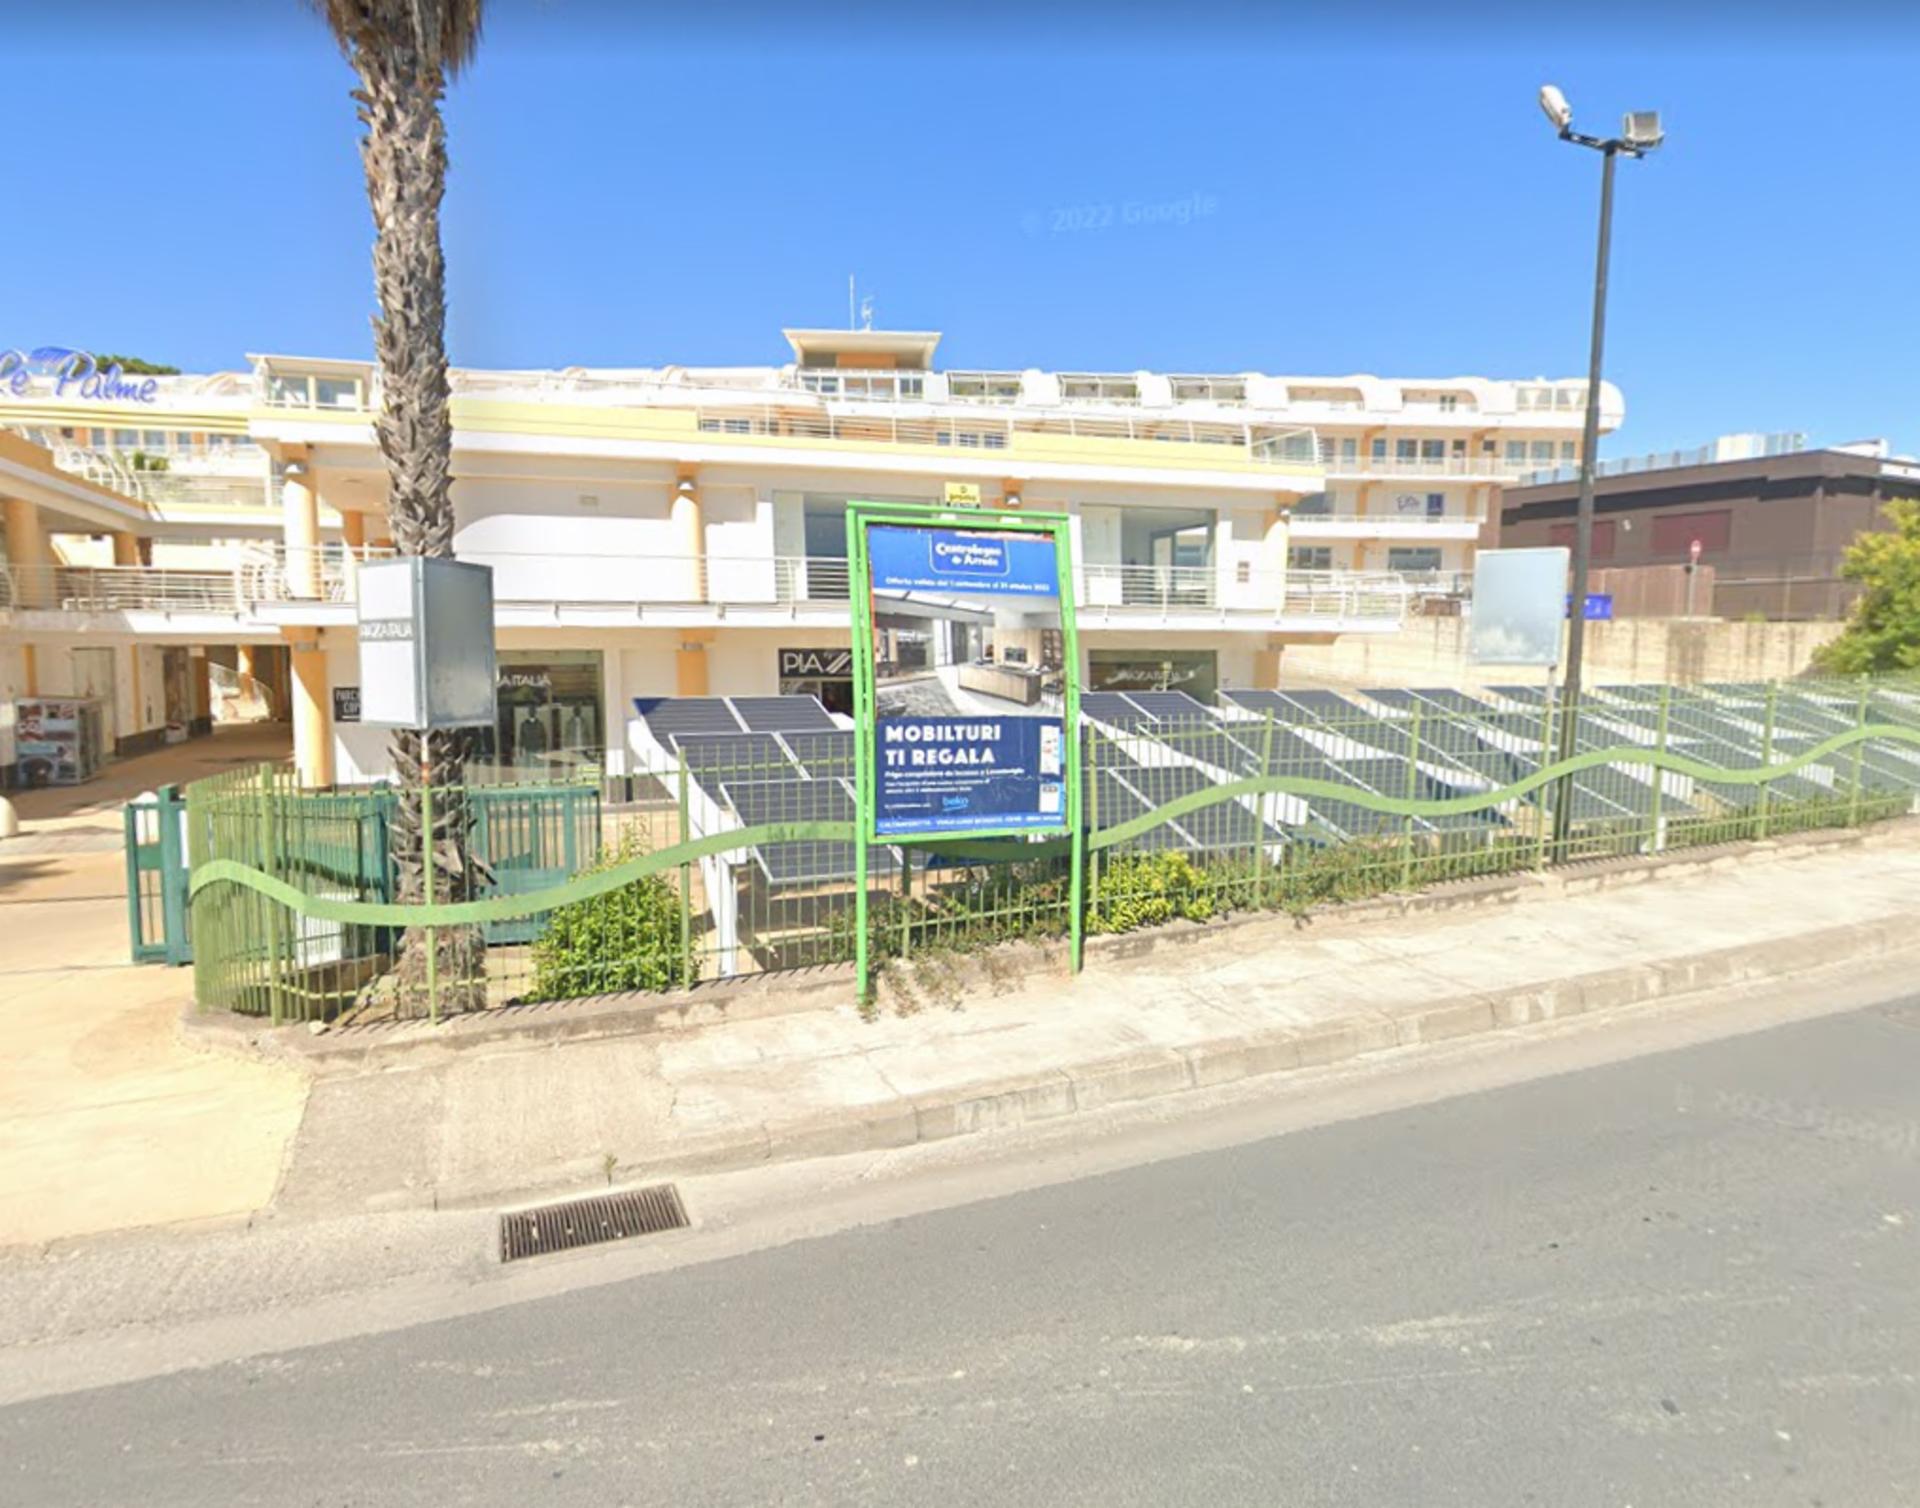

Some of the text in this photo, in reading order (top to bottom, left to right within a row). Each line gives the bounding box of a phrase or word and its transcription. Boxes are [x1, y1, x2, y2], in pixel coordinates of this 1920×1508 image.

[54, 350, 158, 402] Palme
[885, 724, 1001, 742] MOBILTURI
[885, 747, 996, 766] TI REGALA
